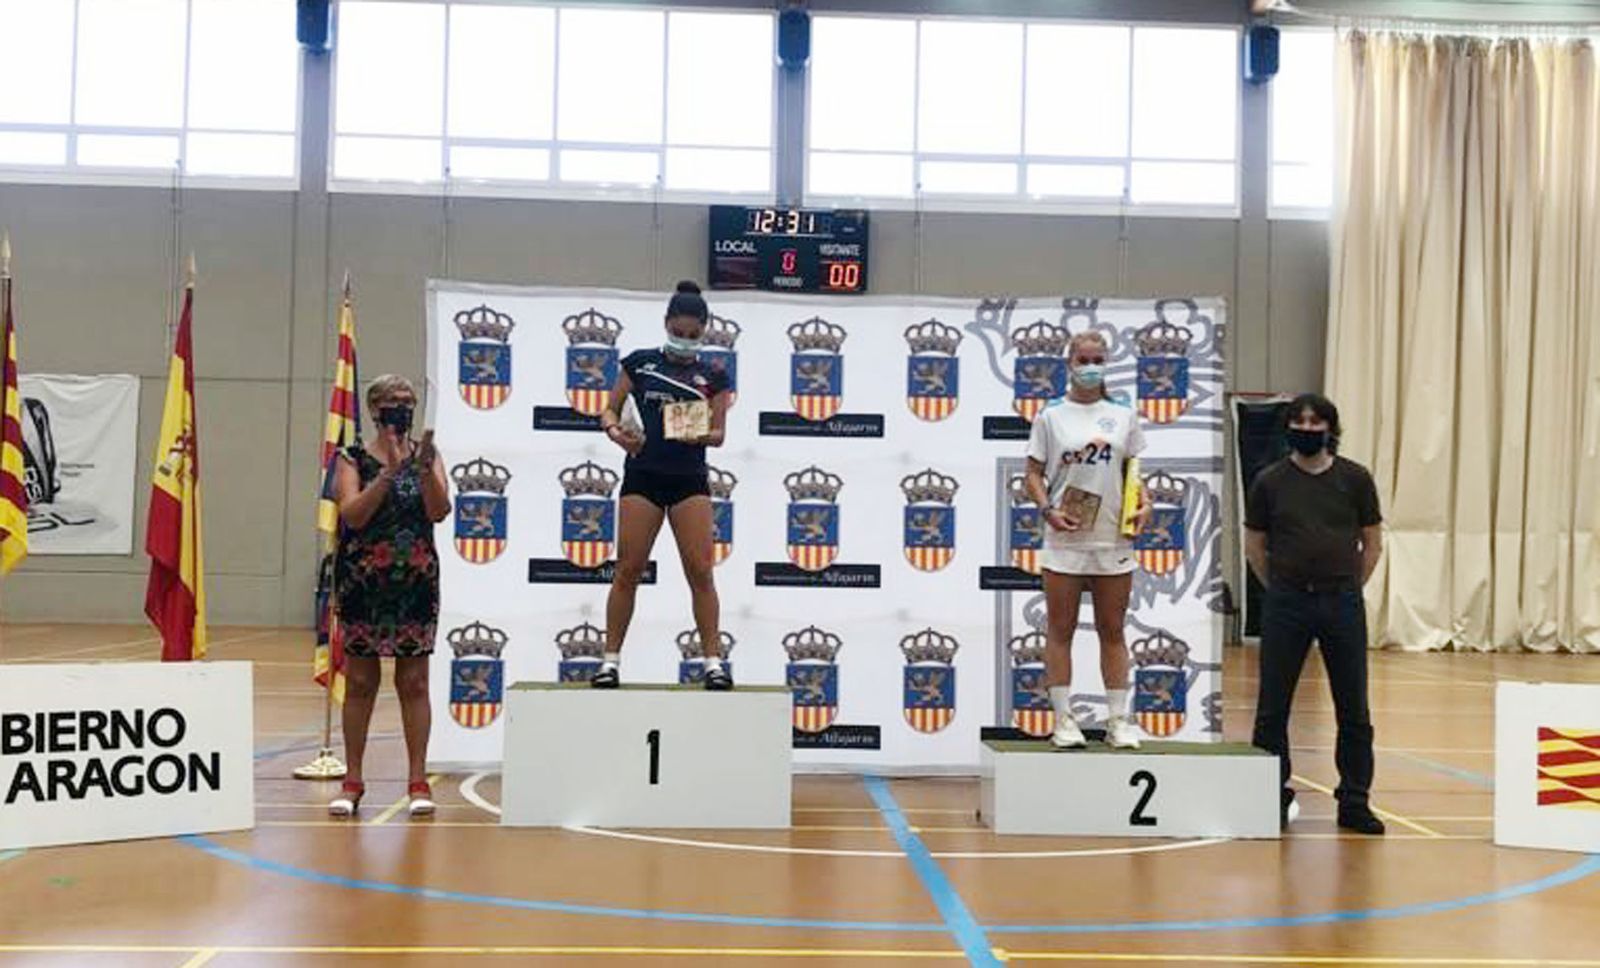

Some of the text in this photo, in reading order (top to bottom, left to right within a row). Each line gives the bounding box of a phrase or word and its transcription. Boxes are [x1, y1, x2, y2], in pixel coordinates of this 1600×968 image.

[753, 209, 815, 233] 12:31
[715, 240, 757, 254] LOCAL
[829, 263, 859, 288] 00
[1, 707, 186, 755] BIERNO
[5, 752, 220, 804] ARAGON
[646, 729, 660, 785] 1
[1129, 769, 1158, 826] 2
